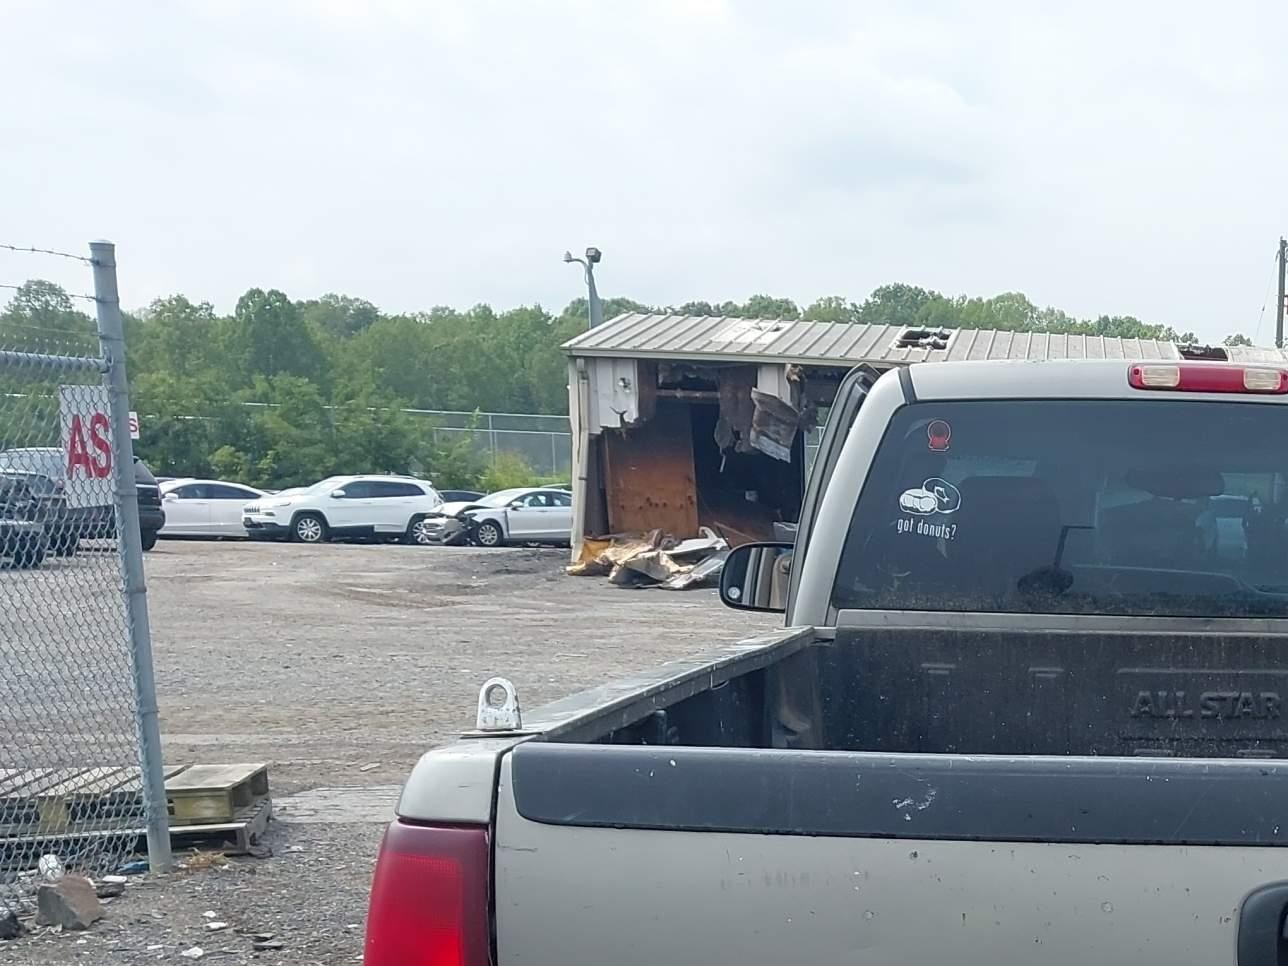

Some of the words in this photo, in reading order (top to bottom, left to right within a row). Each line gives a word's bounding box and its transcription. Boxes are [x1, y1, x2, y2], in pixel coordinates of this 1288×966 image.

[67, 412, 112, 479] AS
[897, 518, 914, 533] got
[917, 519, 957, 540] donuts?
[1130, 690, 1193, 719] ALL
[1200, 690, 1281, 719] STAR
